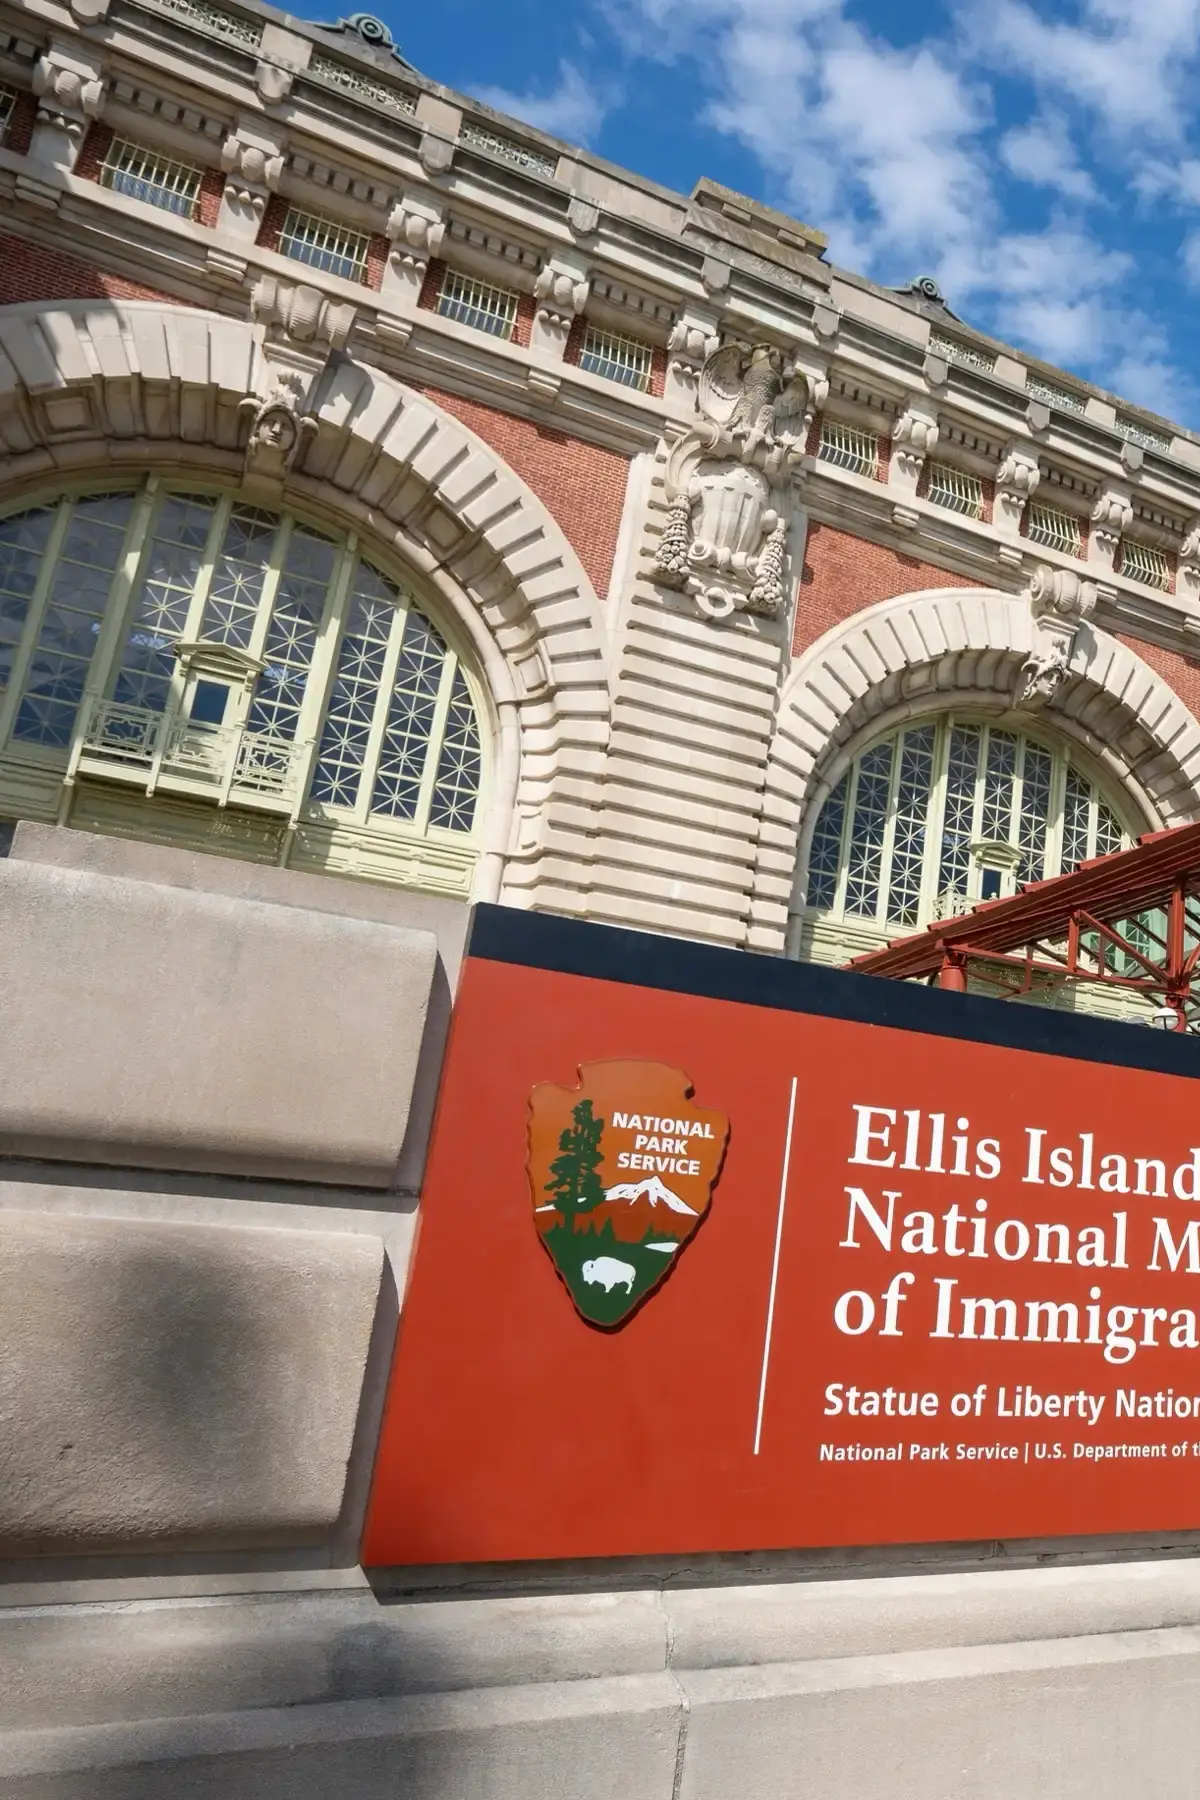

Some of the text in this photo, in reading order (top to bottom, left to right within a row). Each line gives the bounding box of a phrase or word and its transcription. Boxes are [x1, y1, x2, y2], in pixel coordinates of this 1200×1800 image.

[613, 1112, 714, 1138] NATIONAL
[847, 1104, 1001, 1179] Ellis
[635, 1135, 688, 1155] PARK
[617, 1153, 700, 1175] SERVICE
[838, 1186, 1129, 1269] National
[834, 1271, 916, 1336] of
[823, 1383, 939, 1417] Statue
[950, 1383, 987, 1417] of
[997, 1386, 1106, 1426] Liberty
[819, 1442, 903, 1461] National
[909, 1442, 950, 1461] Park
[956, 1443, 1019, 1461] Service
[1034, 1442, 1067, 1459] U.S.
[1073, 1442, 1167, 1462] Department
[1171, 1441, 1189, 1457] of
